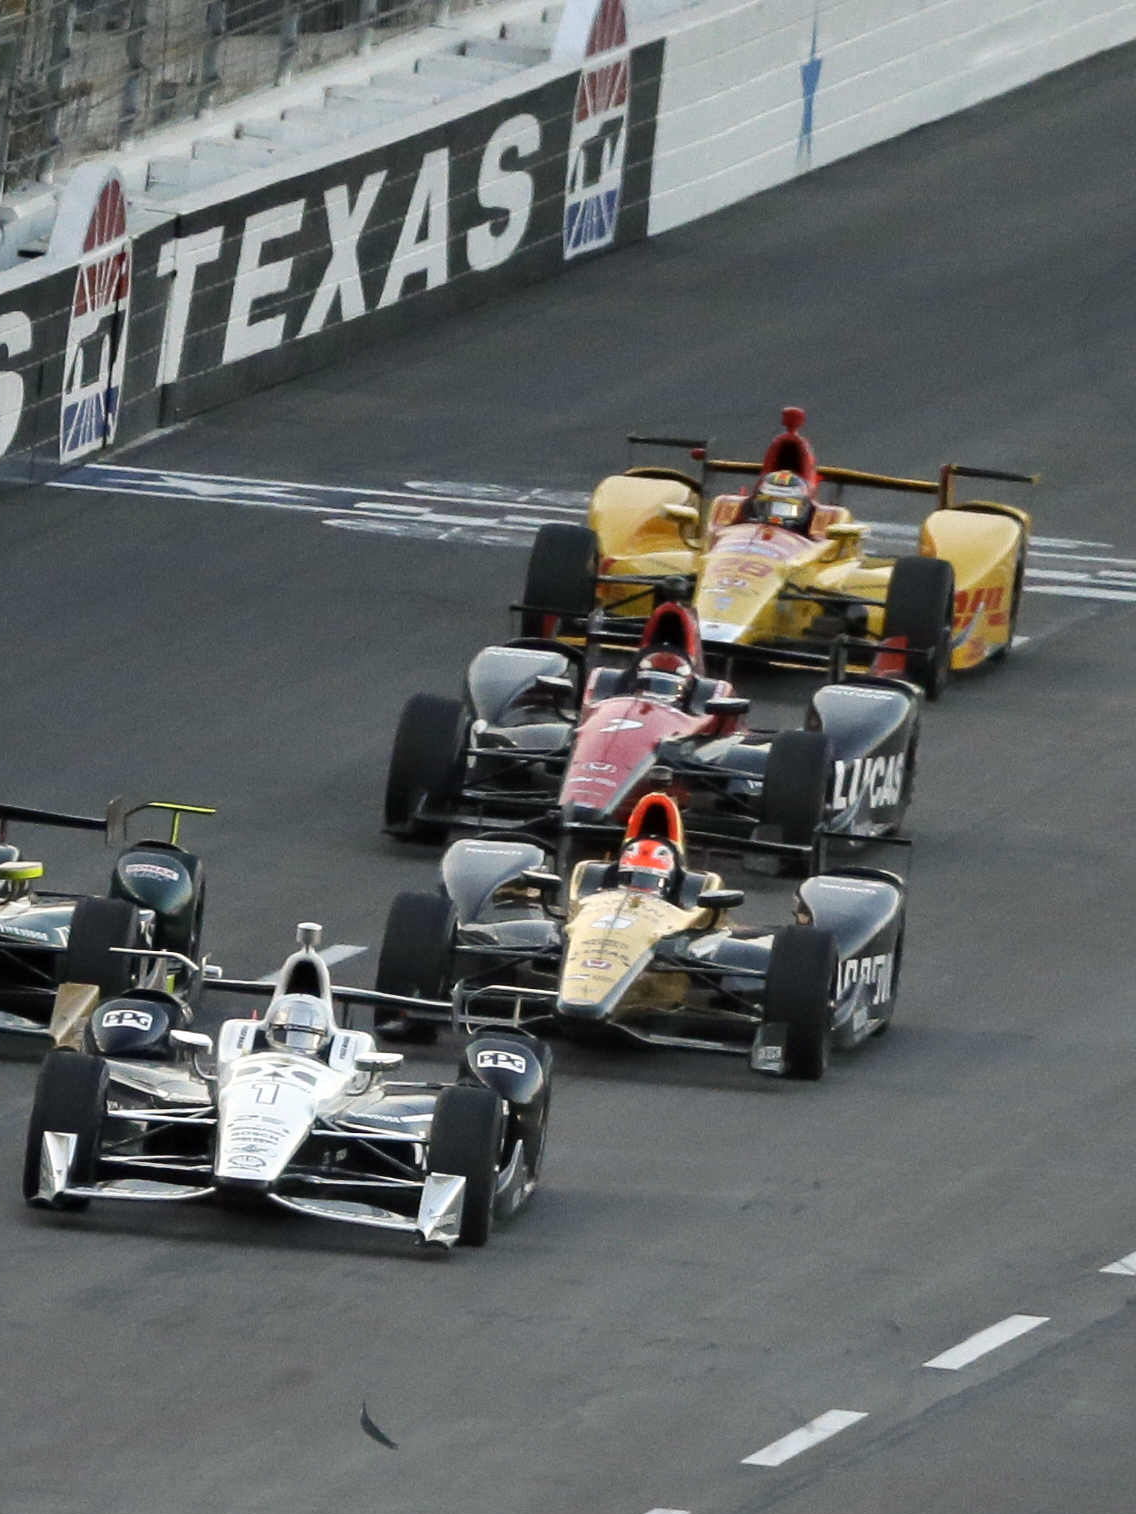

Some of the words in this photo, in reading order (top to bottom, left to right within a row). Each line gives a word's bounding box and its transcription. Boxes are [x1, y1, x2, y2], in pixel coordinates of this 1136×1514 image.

[155, 113, 542, 387] TEXAS
[832, 752, 905, 809] LUCAS
[104, 1011, 151, 1027] PPG
[480, 1053, 525, 1070] PPG
[252, 1083, 280, 1105] 1
